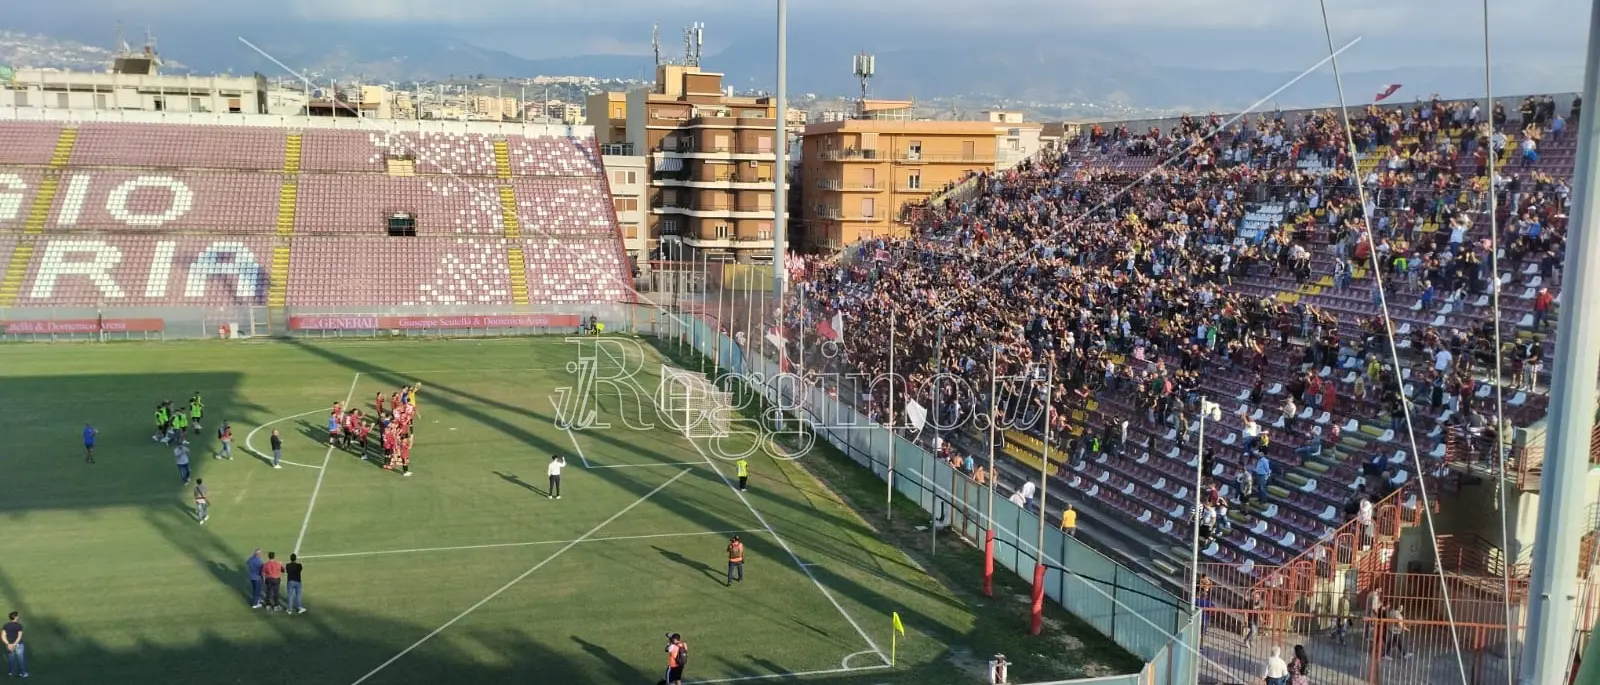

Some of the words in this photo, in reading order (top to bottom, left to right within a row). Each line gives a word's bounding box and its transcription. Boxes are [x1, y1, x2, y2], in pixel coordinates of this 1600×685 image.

[30, 240, 261, 298] RIA
[34, 322, 44, 332] &
[48, 322, 96, 332] Domenico
[319, 317, 378, 329] GENERALI
[399, 318, 438, 328] Giuseppe
[473, 317, 480, 326] &
[484, 317, 525, 326] Domenico
[526, 317, 549, 326] Arena
